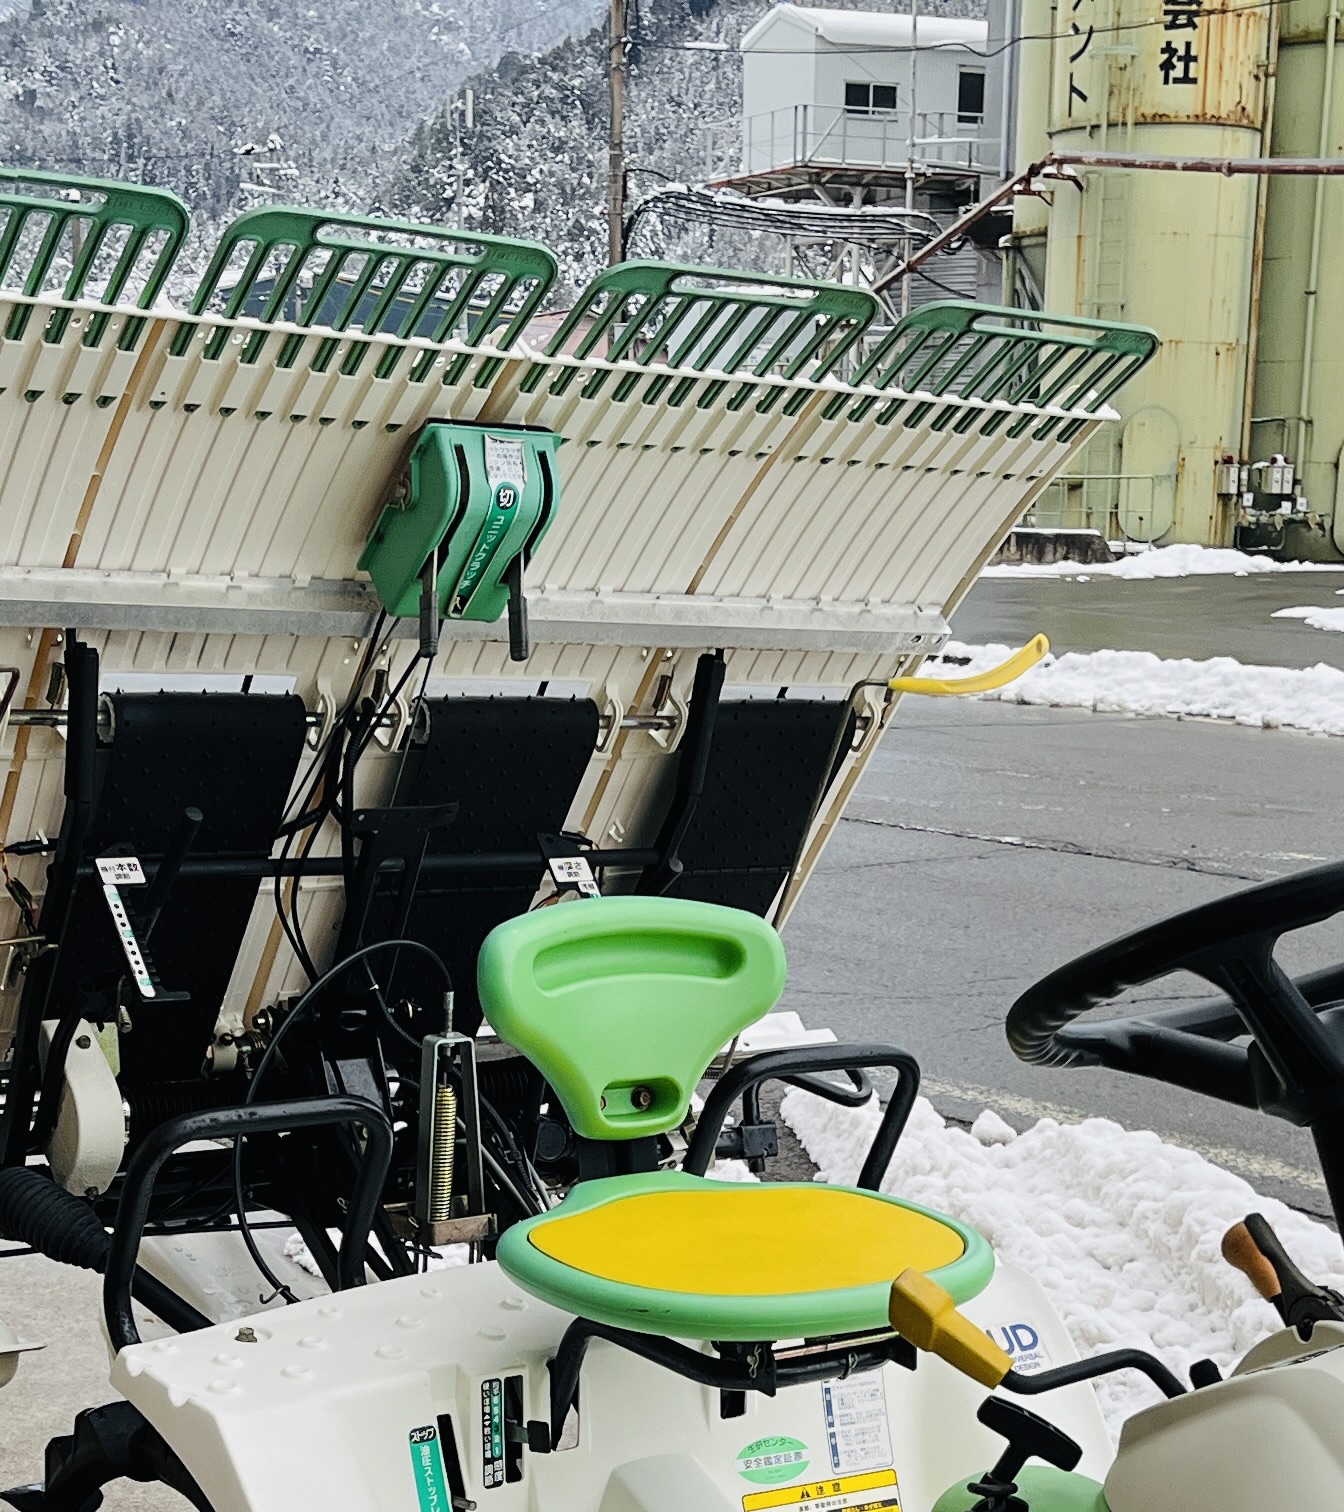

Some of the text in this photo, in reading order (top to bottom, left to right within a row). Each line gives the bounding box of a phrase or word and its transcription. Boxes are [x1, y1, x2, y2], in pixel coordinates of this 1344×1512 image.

[1068, 0, 1093, 118] ント
[1159, 0, 1202, 85] 会社
[499, 488, 515, 507] 切
[459, 516, 505, 589] ユニットクラッチ
[986, 1324, 1038, 1355] UD
[411, 1427, 435, 1443] ストップ
